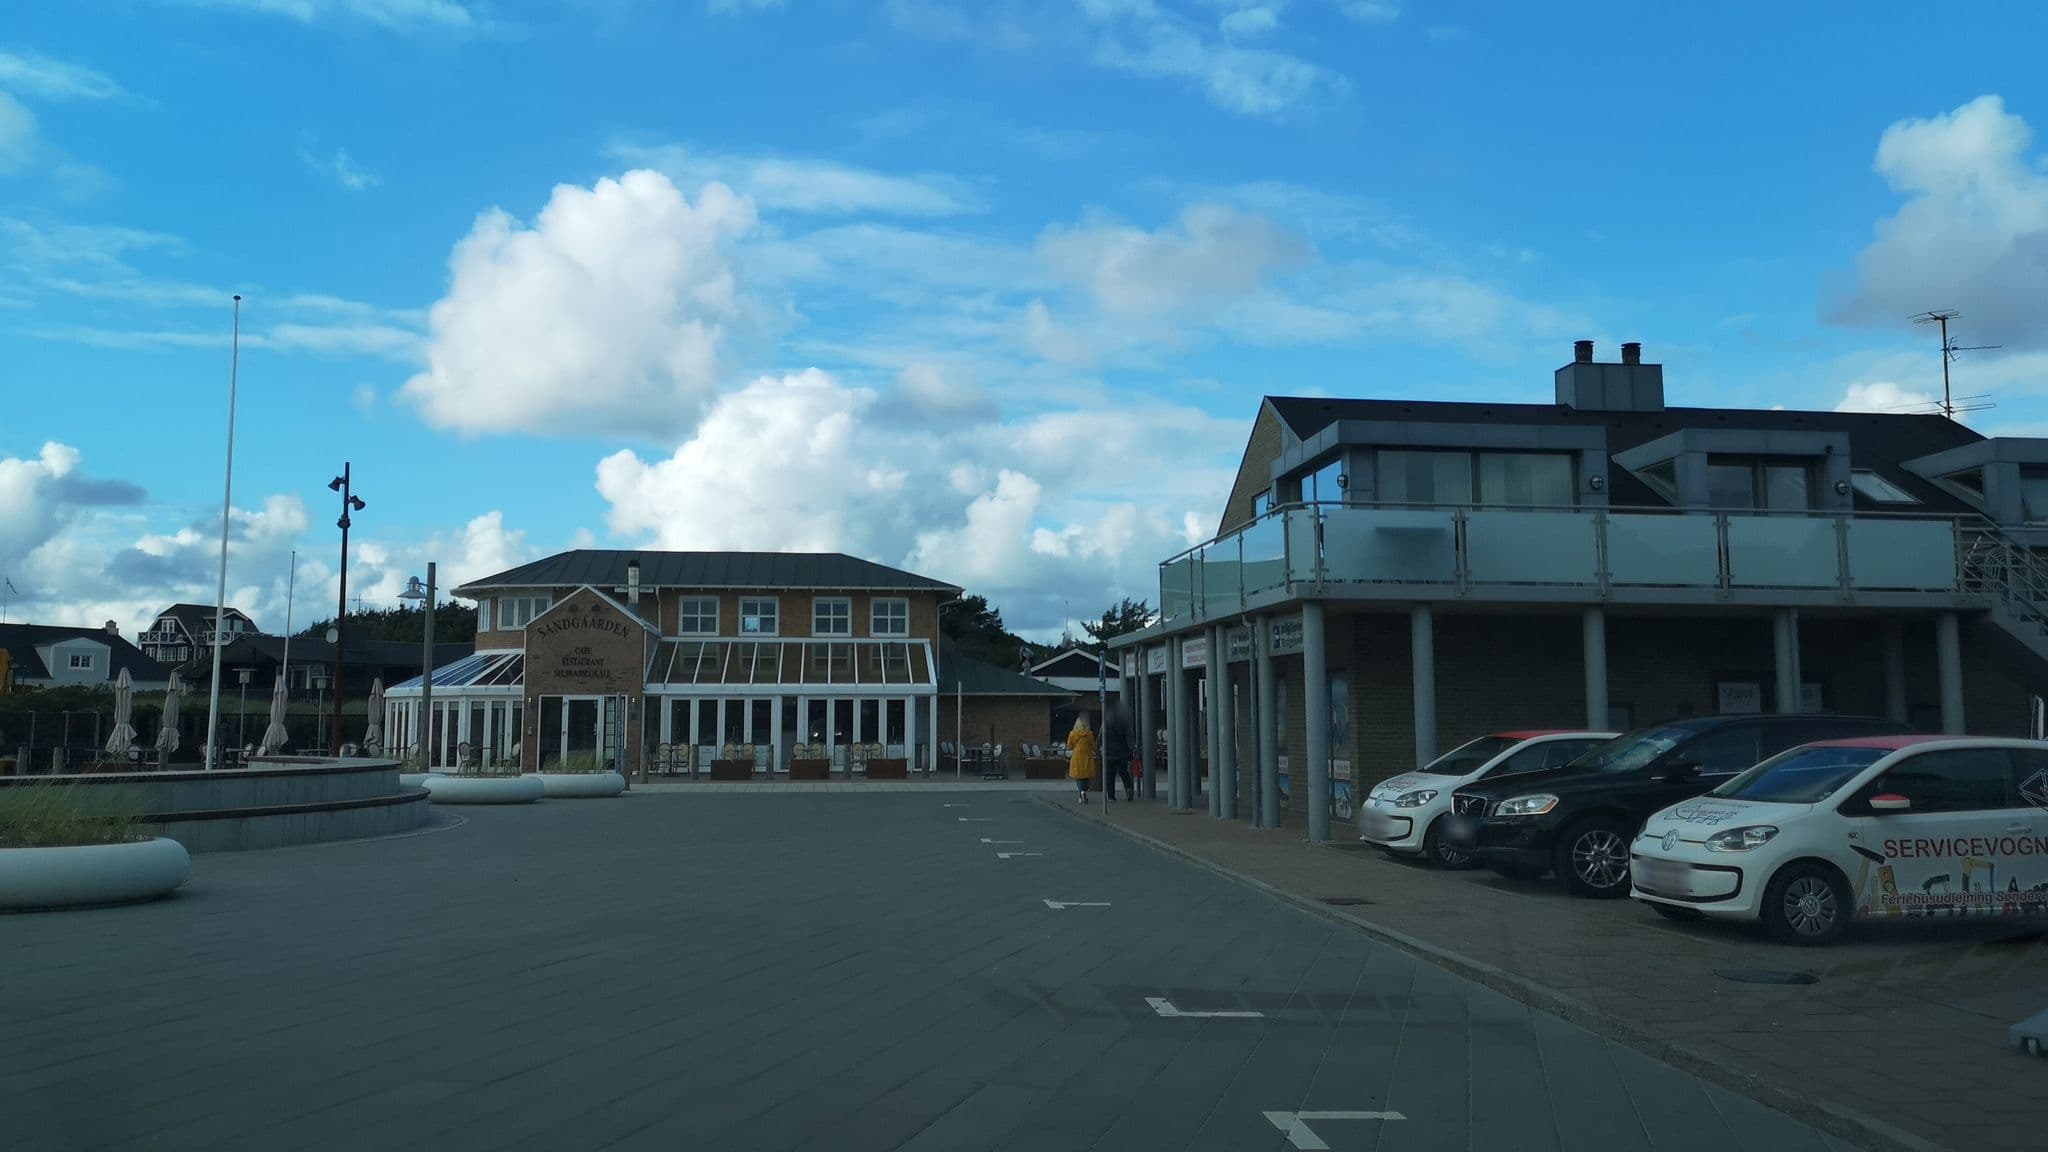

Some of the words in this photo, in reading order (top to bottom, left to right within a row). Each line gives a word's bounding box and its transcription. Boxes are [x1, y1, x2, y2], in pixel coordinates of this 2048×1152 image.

[537, 616, 630, 638] SANDGAARDEN
[561, 657, 604, 666] RESTAURANT
[1883, 836, 2048, 859] SERVICEVOGN
